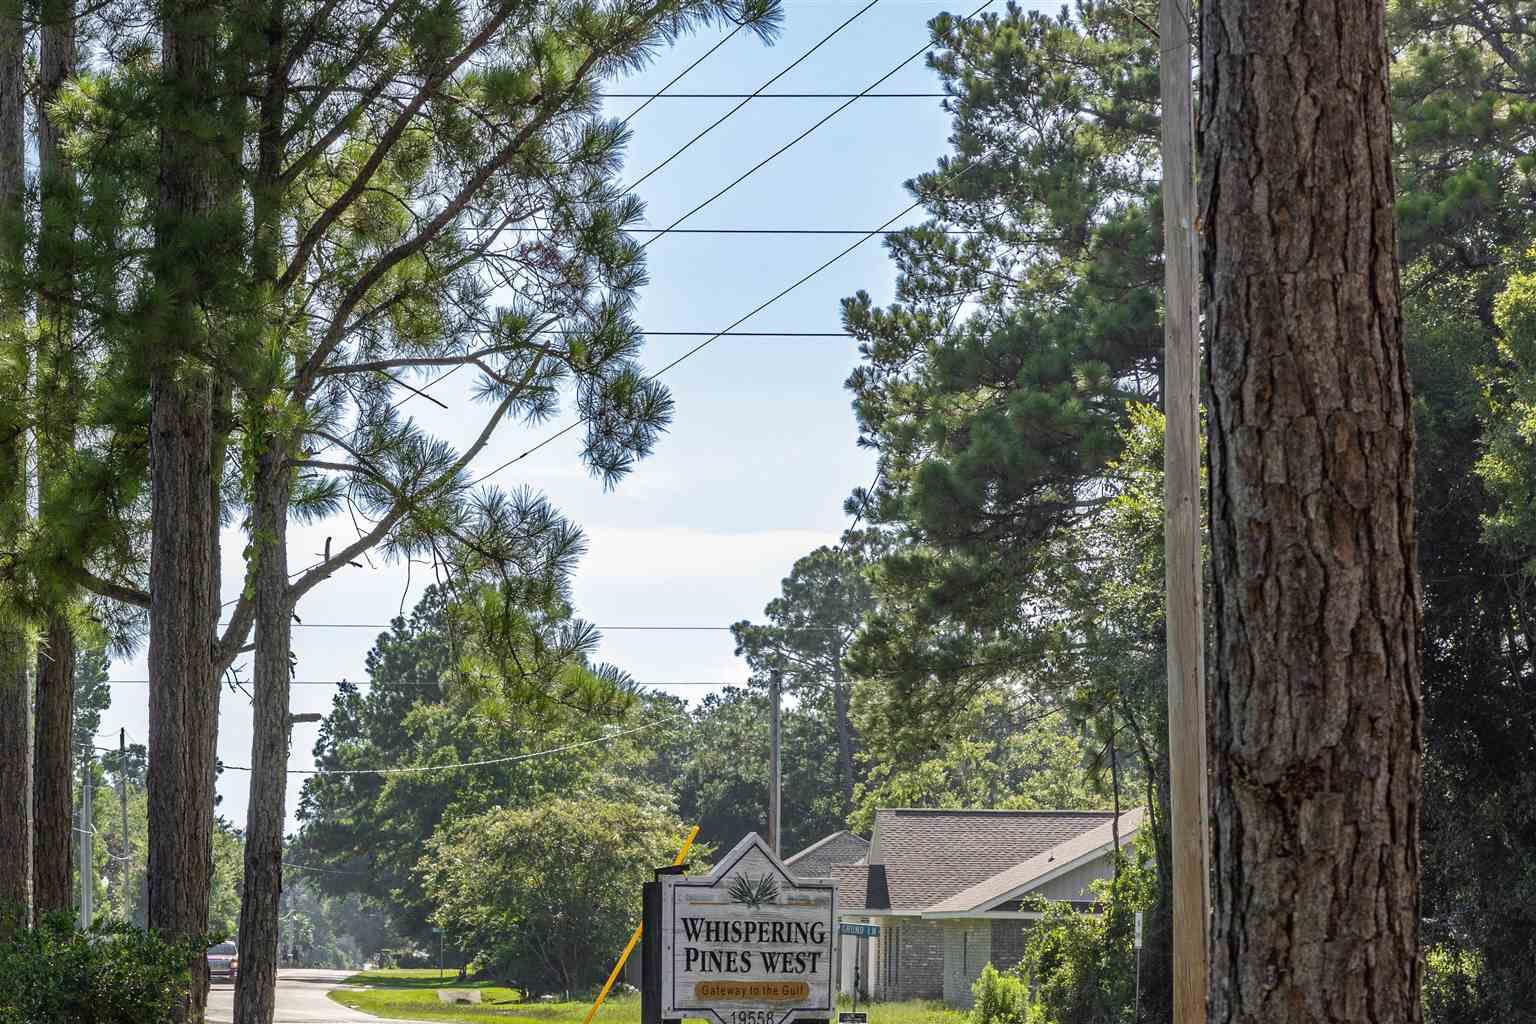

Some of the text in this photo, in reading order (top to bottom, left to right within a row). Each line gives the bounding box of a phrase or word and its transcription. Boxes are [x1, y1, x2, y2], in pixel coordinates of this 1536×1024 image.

[681, 917, 825, 944] WHISPERING
[684, 947, 822, 974] PINES WEST
[702, 984, 804, 998] Gateway to the Gulf
